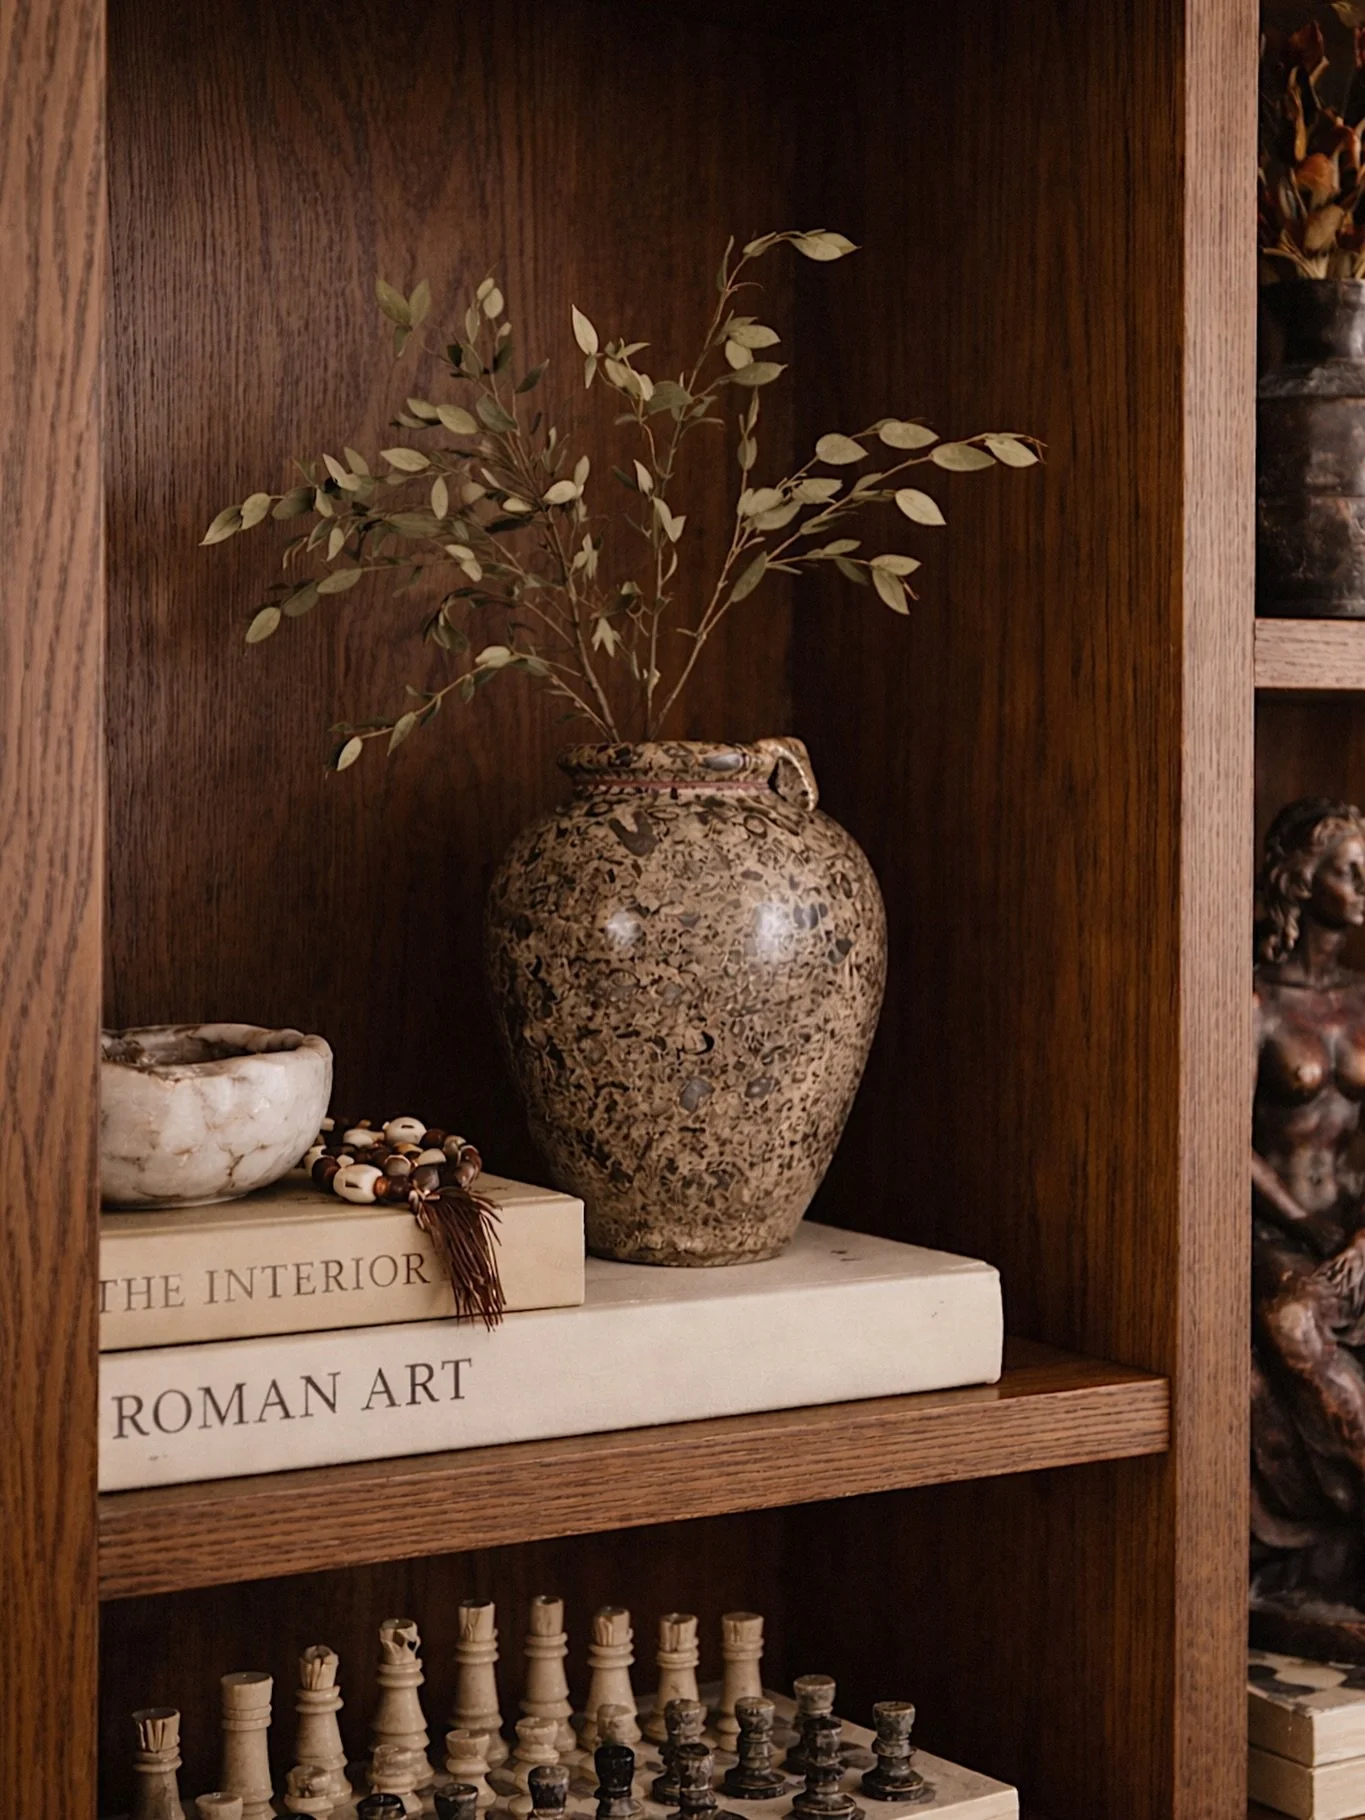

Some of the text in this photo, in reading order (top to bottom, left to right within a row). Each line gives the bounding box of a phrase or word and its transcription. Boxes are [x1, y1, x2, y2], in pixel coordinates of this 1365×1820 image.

[98, 1252, 431, 1314] THE INTERIOR
[111, 1358, 472, 1440] ROMAN ART
